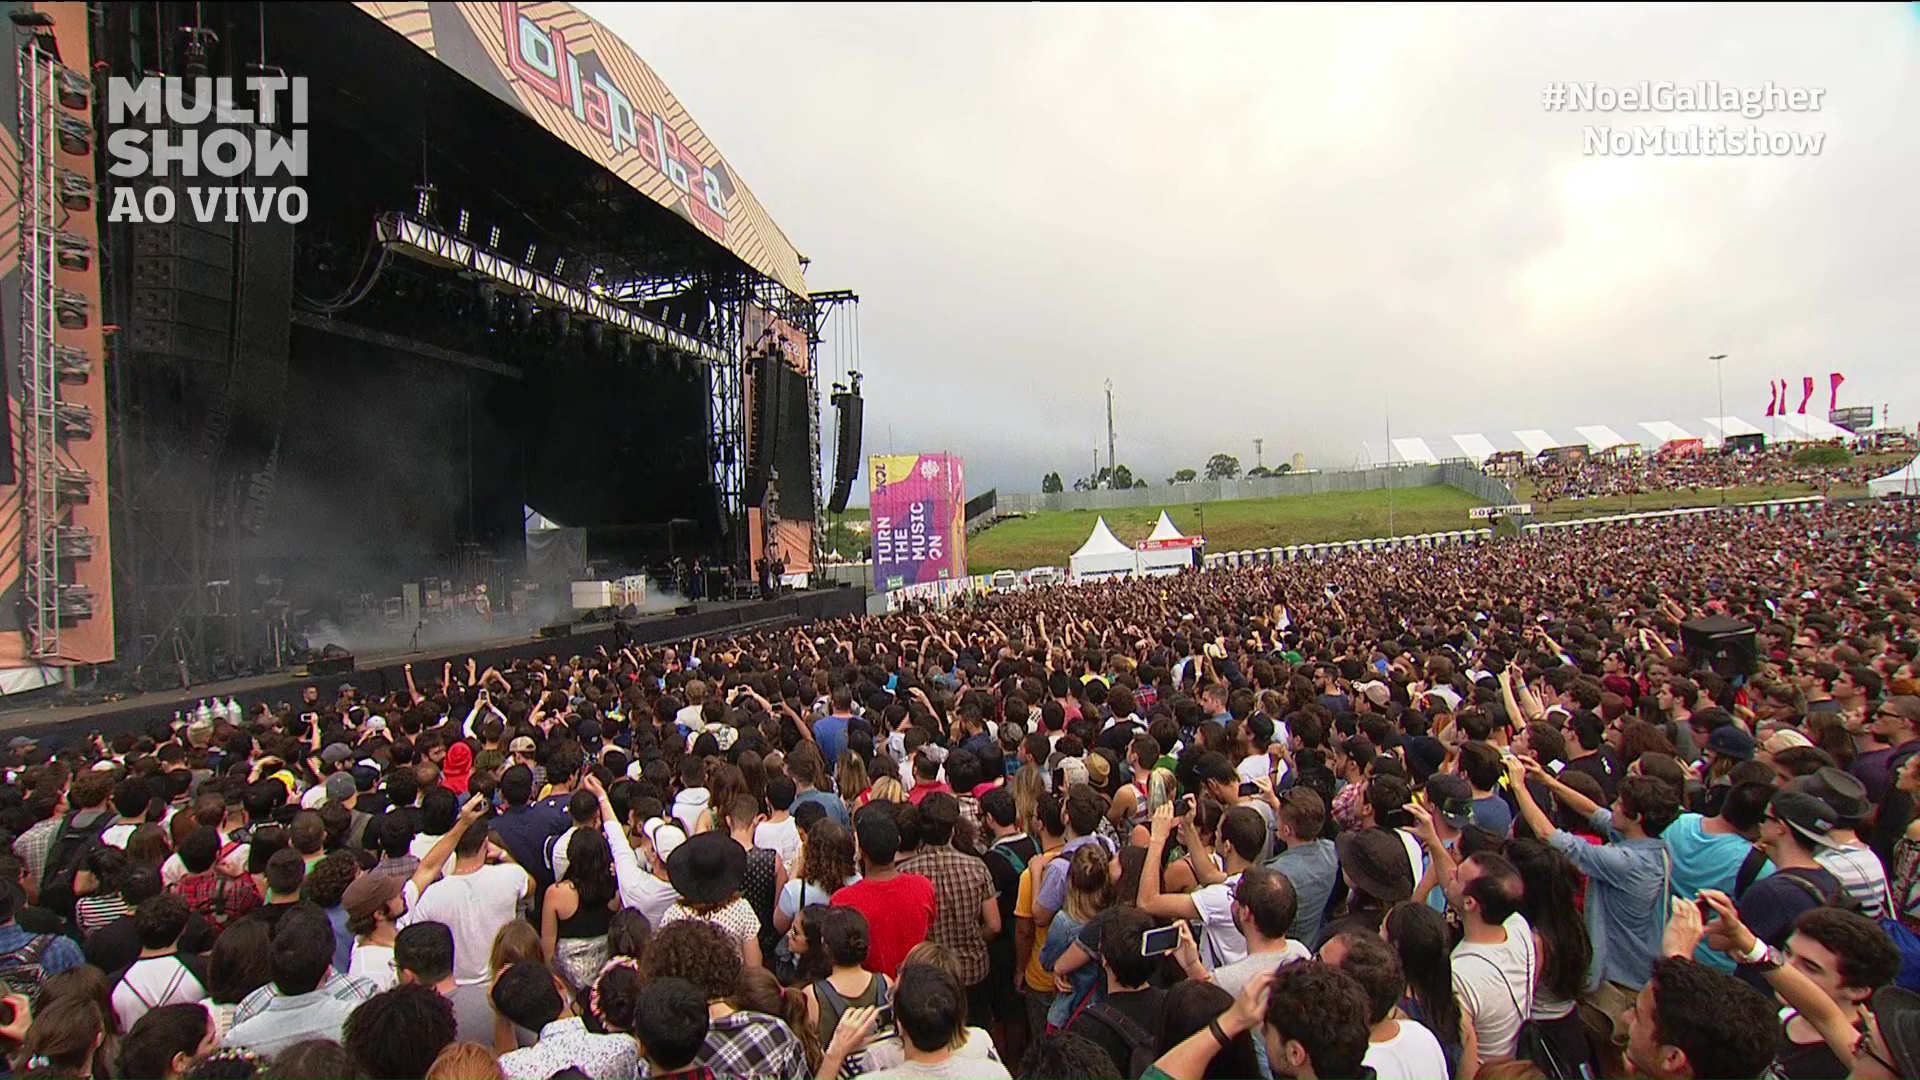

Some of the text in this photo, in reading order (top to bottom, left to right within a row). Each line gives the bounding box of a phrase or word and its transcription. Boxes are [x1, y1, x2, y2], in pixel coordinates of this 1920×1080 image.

[876, 463, 887, 496] SKOL
[877, 516, 892, 565] TURN
[894, 528, 909, 564] THE
[910, 502, 926, 561] MUSIC
[928, 535, 943, 561] ON
